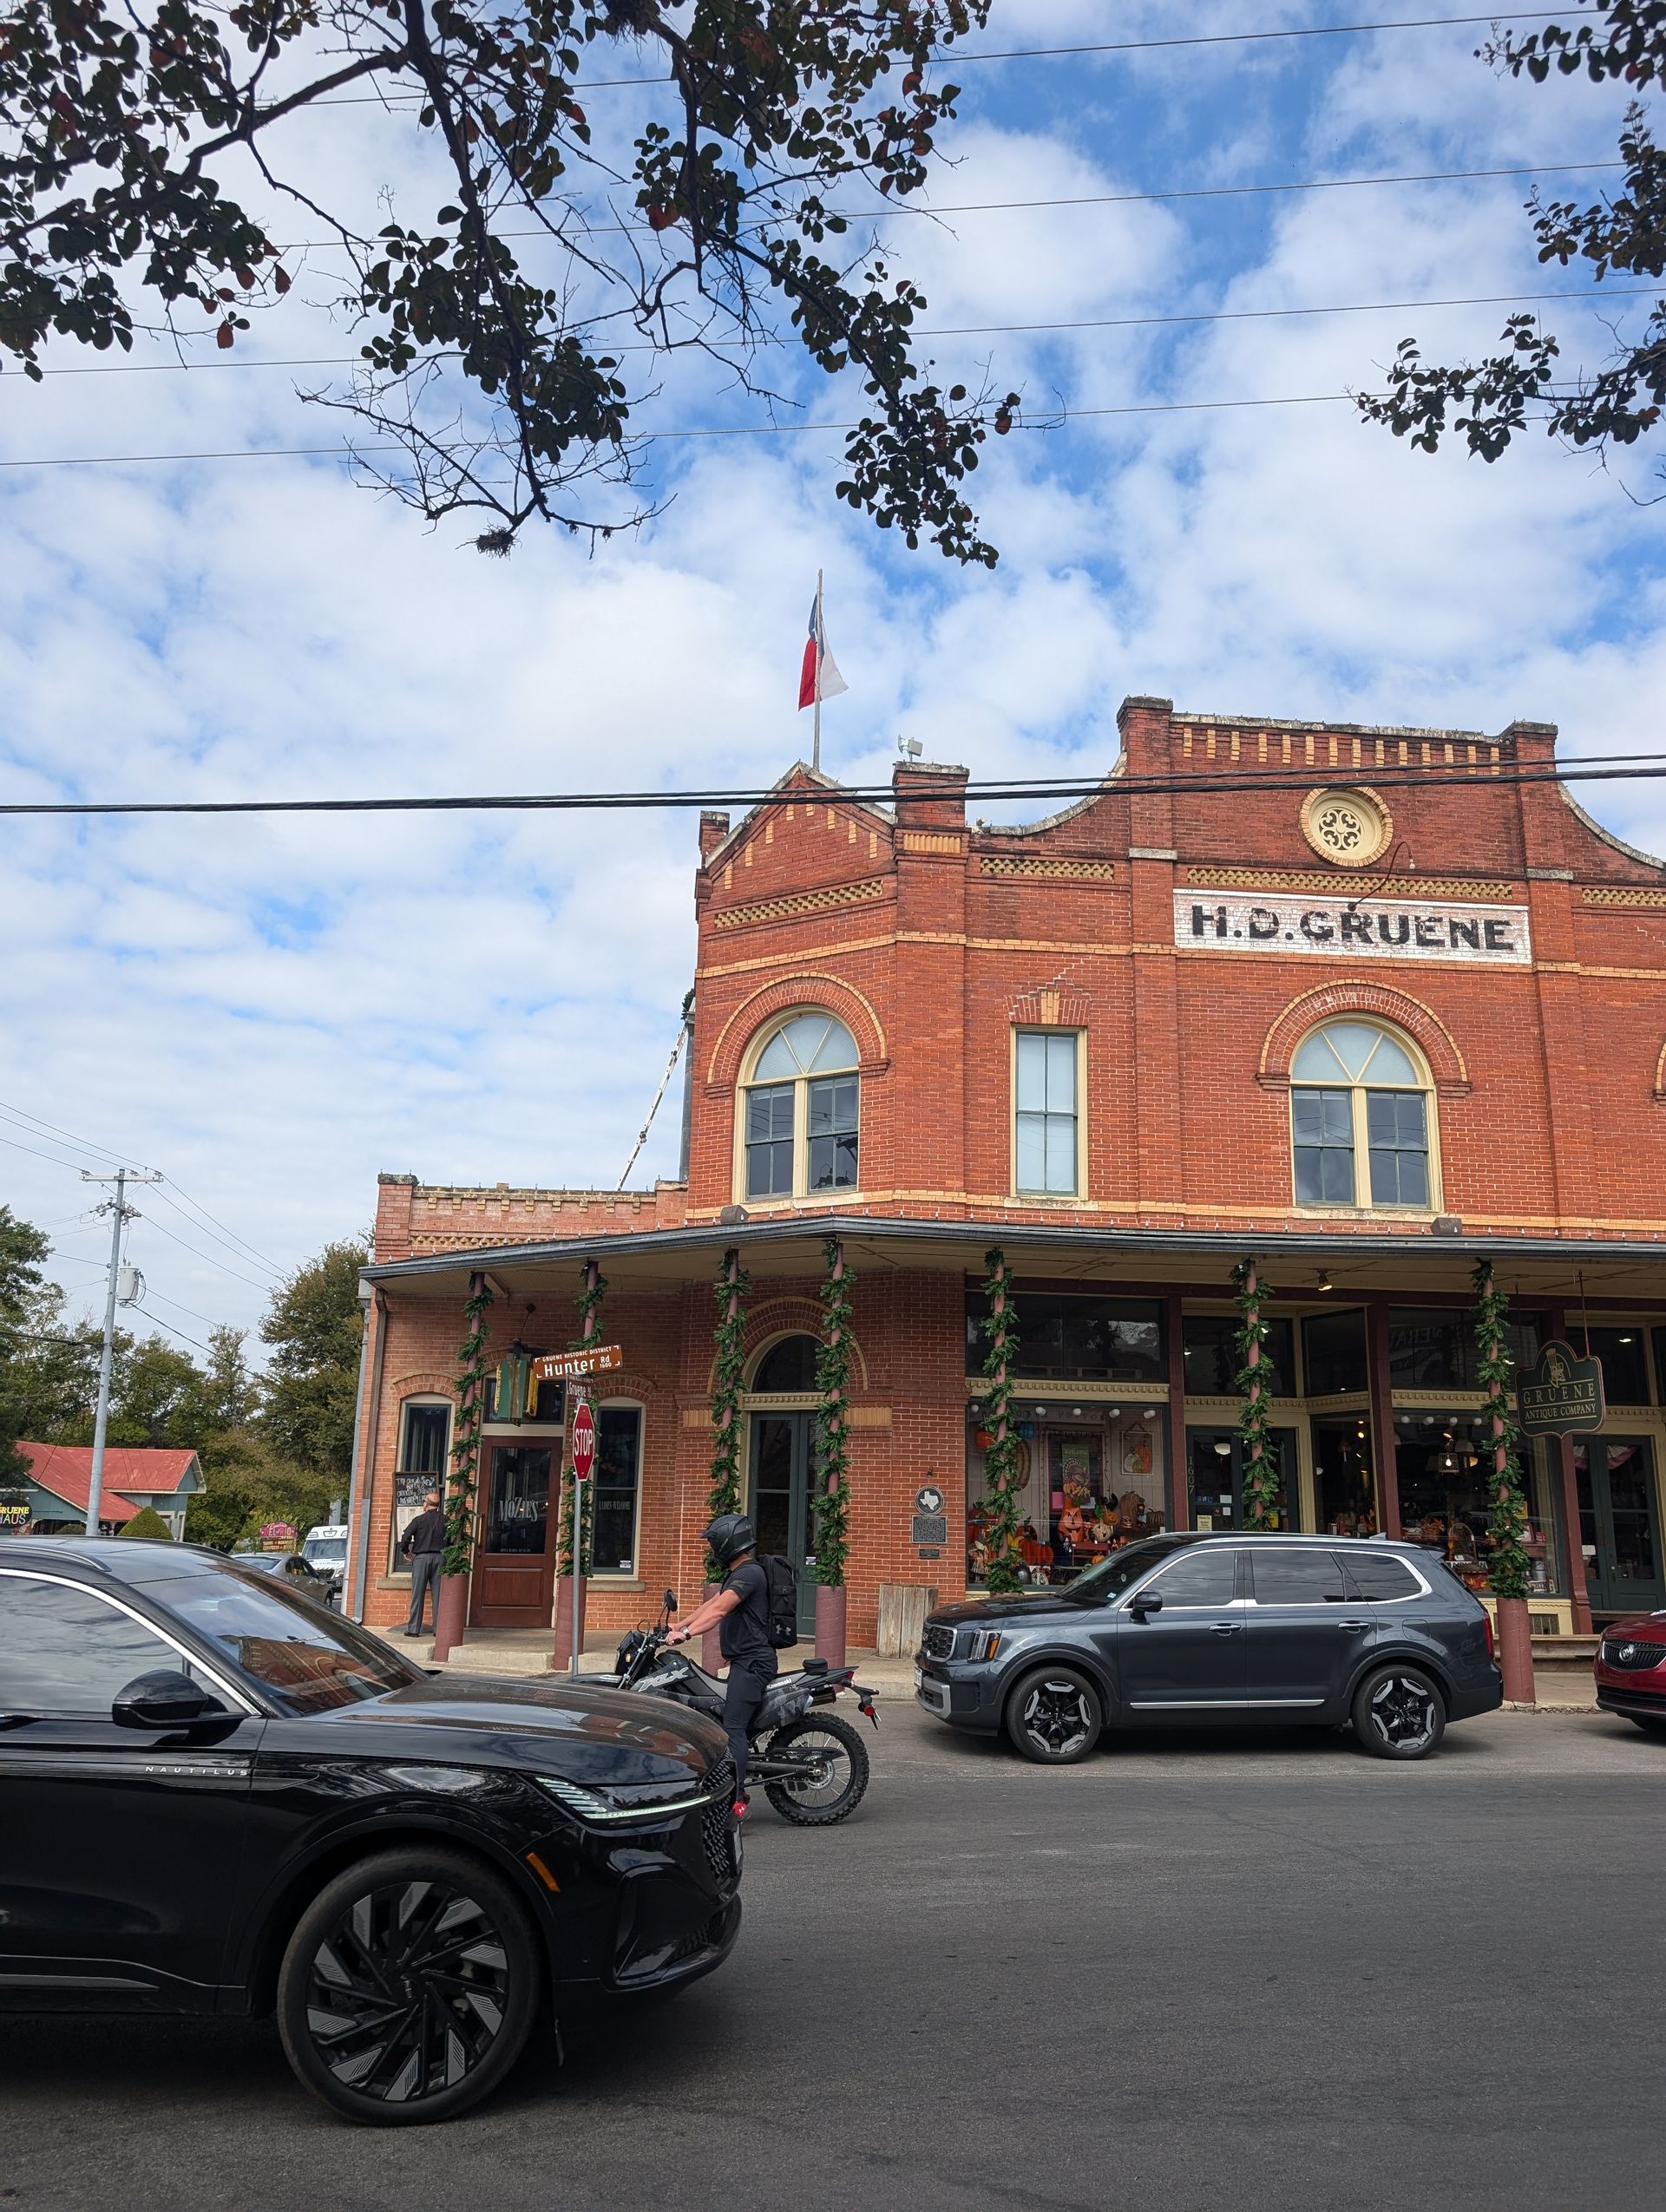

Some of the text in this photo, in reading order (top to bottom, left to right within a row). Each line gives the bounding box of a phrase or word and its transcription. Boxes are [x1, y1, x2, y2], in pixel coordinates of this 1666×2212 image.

[564, 1350, 588, 1359] HISTORIC
[589, 1346, 612, 1355] DISTRICT
[544, 1354, 610, 1378] Hunter Rd
[1523, 1383, 1596, 1404] GRUENE
[1525, 1404, 1597, 1420] ANTIQUE COMPANY
[574, 1428, 593, 1456] STOP
[1063, 1447, 1089, 1456] Welcome
[639, 1666, 689, 1692] KLX
[766, 1678, 793, 1690] Kawasaki
[145, 1766, 248, 1776] NAUTILUS
